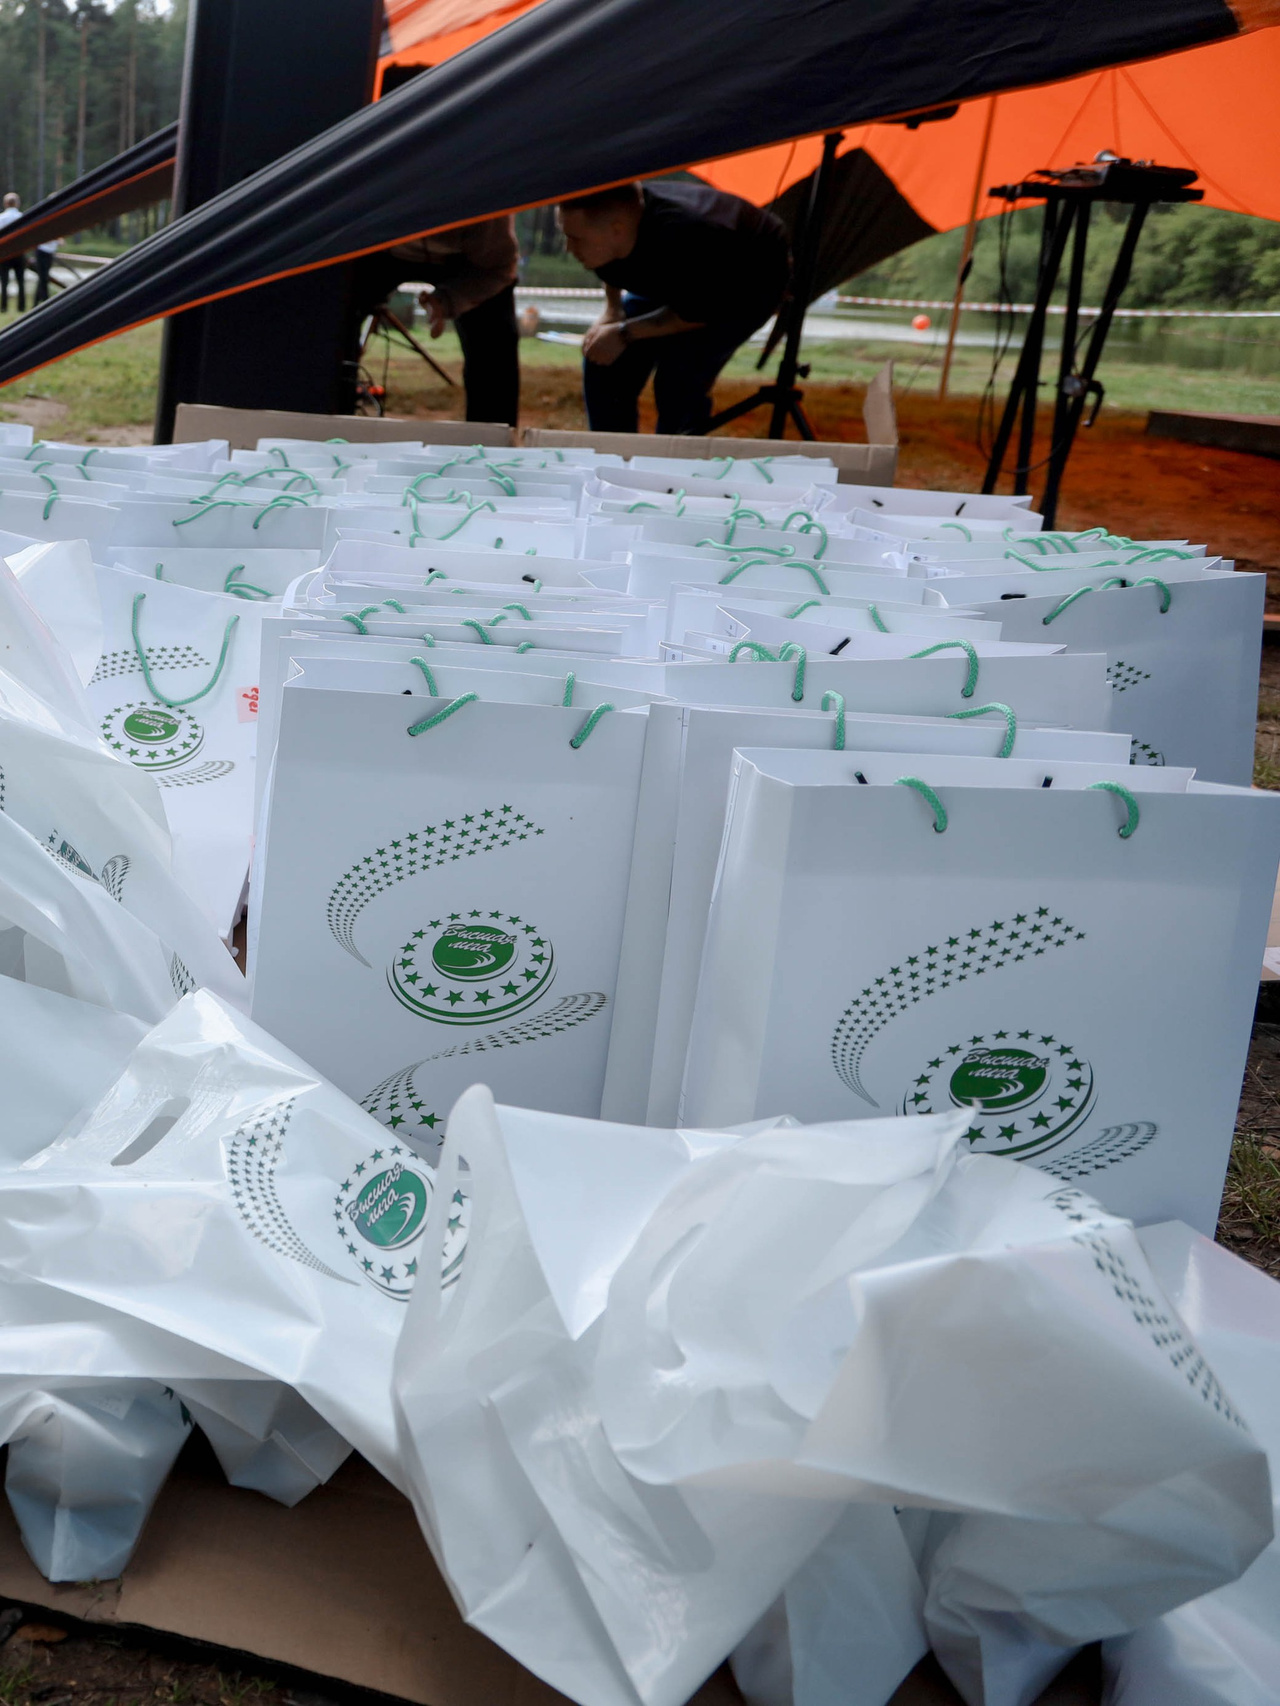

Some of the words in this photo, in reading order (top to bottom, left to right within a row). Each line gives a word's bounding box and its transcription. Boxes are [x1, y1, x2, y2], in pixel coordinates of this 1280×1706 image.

[442, 924, 517, 945] Высшая
[448, 941, 493, 953] лига
[962, 1048, 1051, 1069] Высшая
[969, 1067, 1021, 1080] лига
[345, 1162, 405, 1222] Высшая
[366, 1188, 400, 1227] лига
